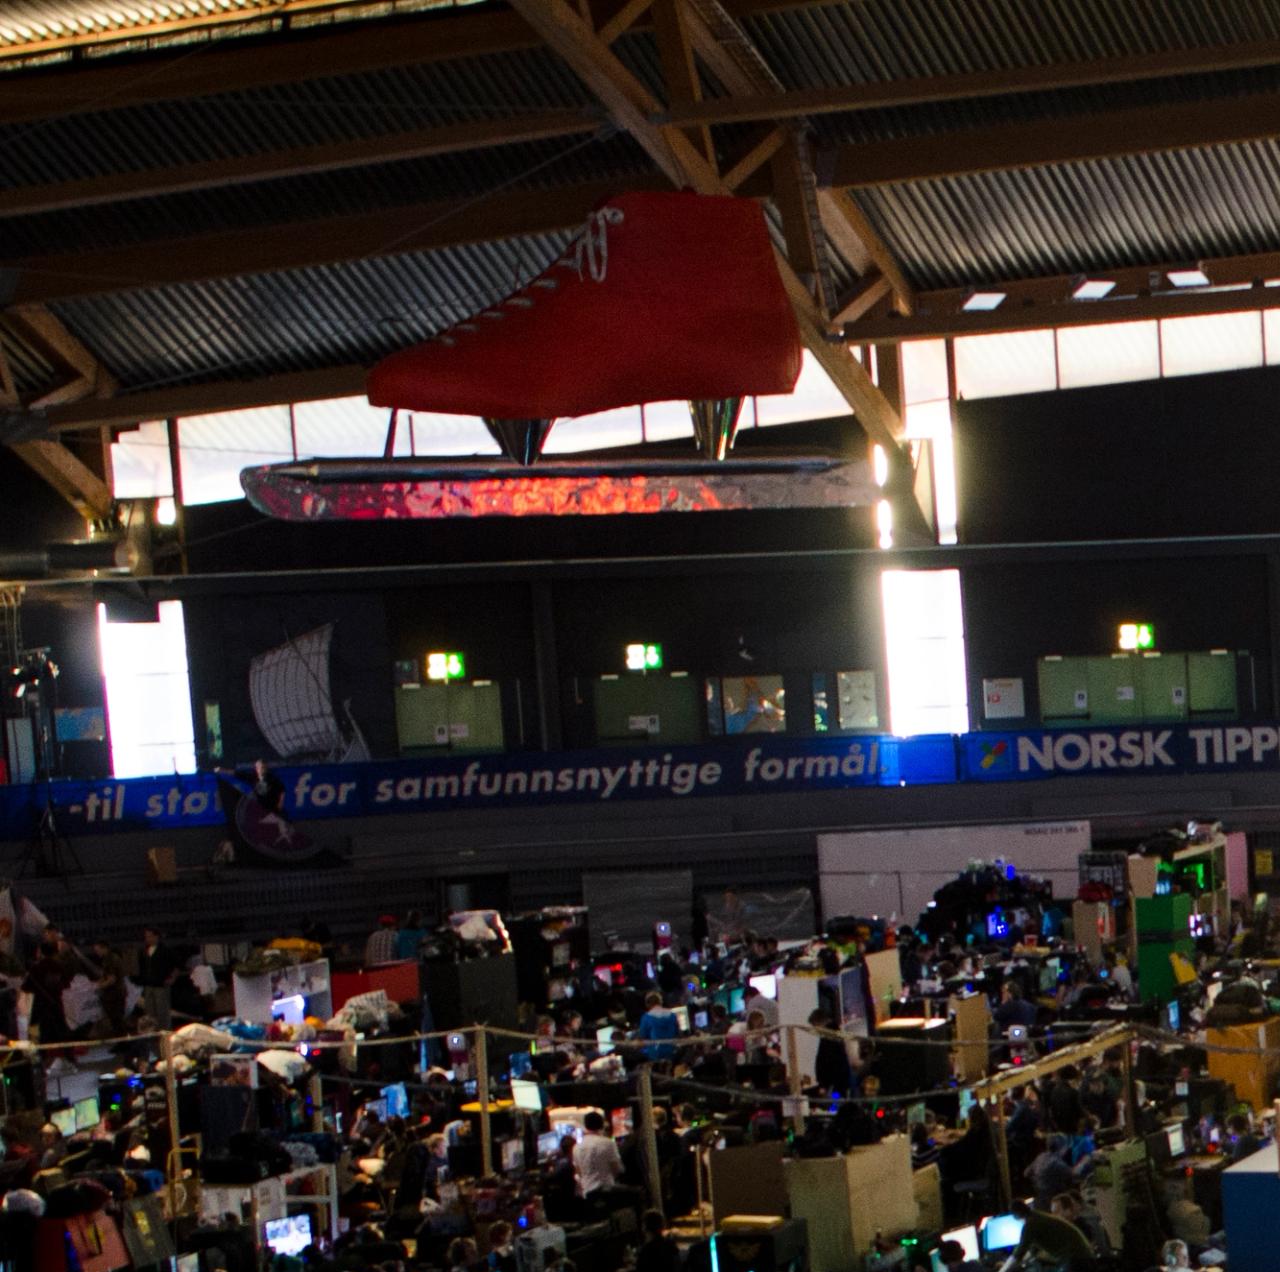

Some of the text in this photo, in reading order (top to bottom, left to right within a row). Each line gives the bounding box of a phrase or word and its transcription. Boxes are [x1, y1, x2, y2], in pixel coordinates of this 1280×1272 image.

[1017, 730, 1175, 772] NORSK
[295, 771, 356, 808] for
[375, 753, 722, 803] samfunnsnyttige
